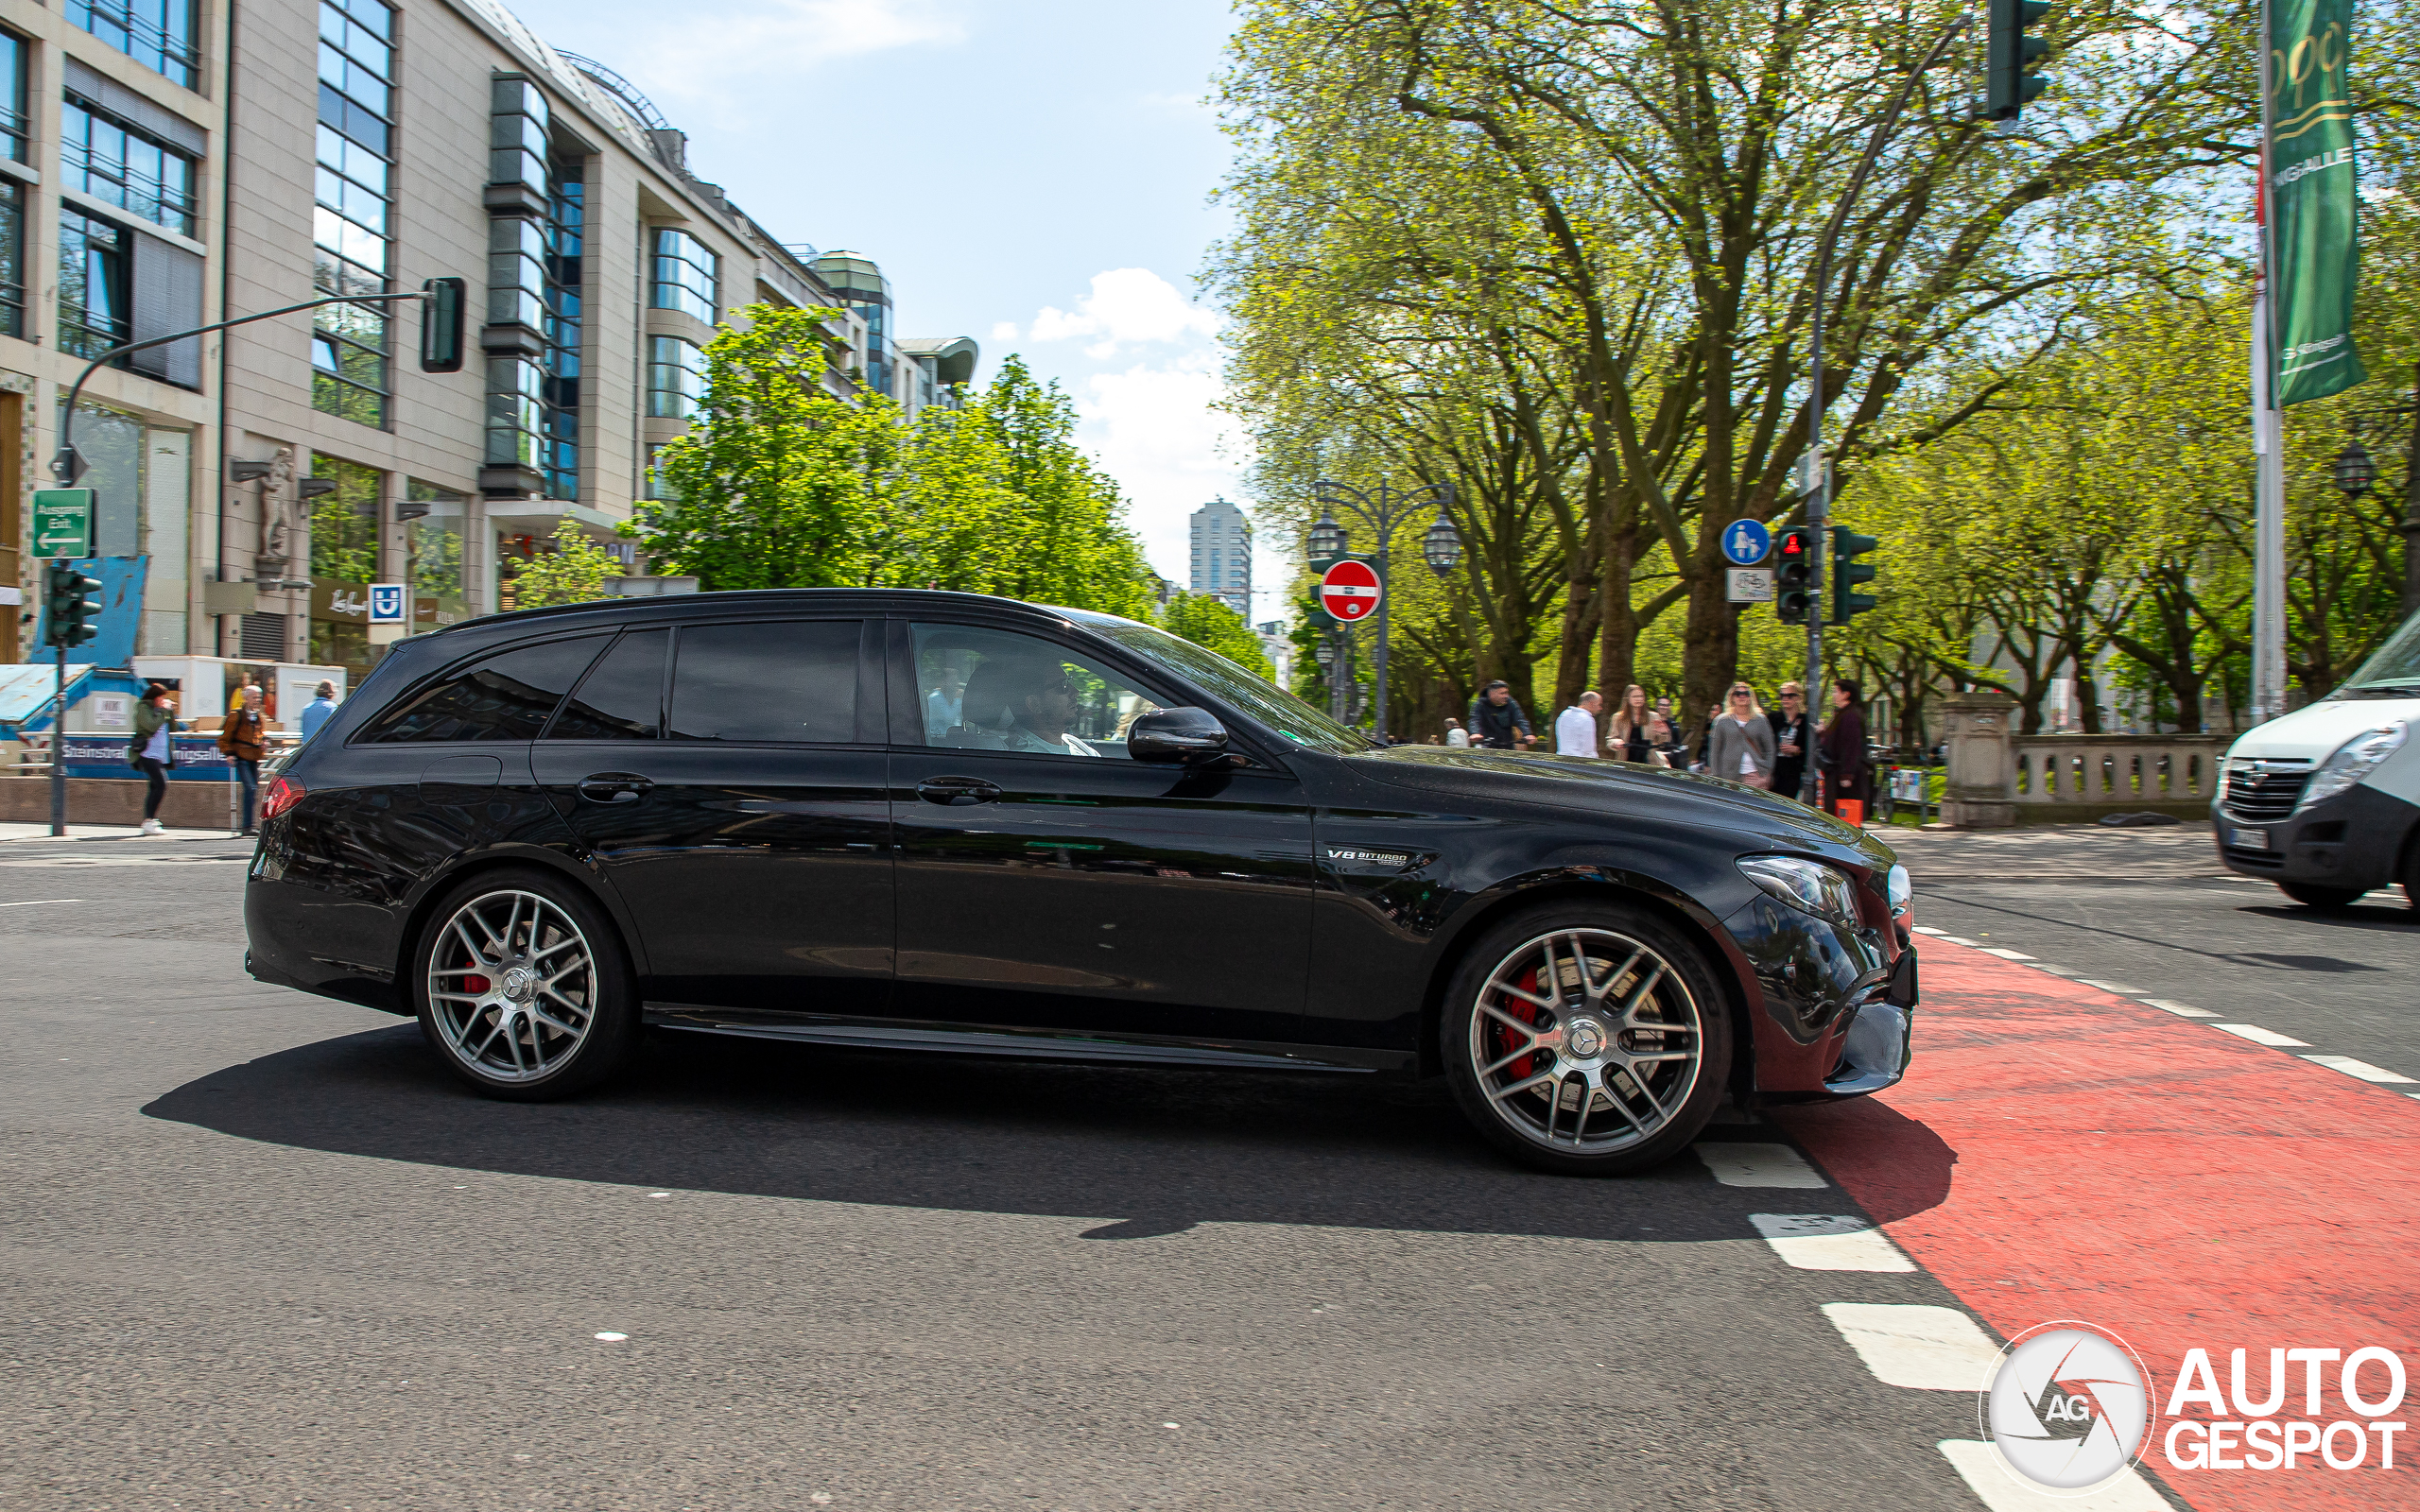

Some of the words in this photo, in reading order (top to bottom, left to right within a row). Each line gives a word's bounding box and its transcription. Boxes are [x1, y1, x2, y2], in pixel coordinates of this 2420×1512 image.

[38, 505, 85, 517] Ausgang
[48, 518, 72, 529] Exit
[1327, 850, 1356, 860] V8
[1357, 851, 1408, 861] BITURBO
